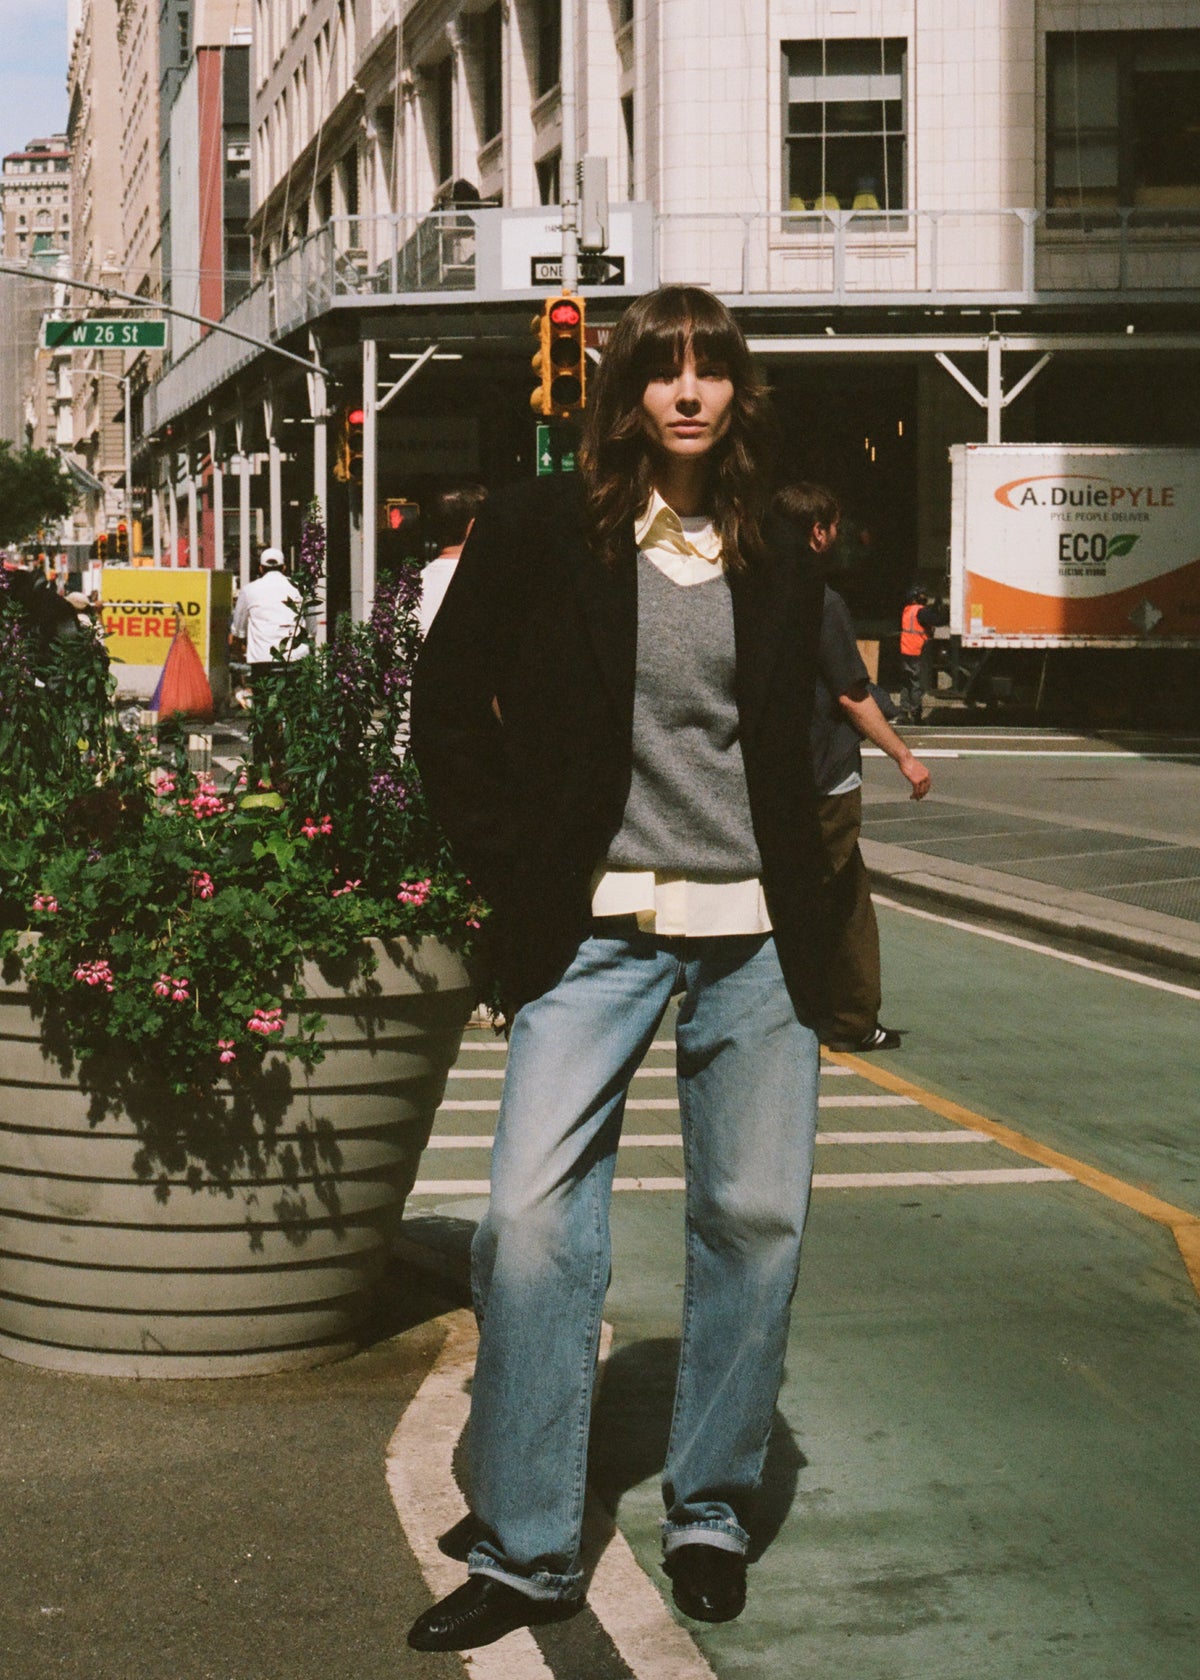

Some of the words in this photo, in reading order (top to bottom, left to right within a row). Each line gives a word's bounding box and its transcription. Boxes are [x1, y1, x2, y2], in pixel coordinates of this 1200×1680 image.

[73, 326, 87, 342] W
[94, 326, 115, 342] 26
[121, 326, 138, 342] St
[1020, 487, 1046, 506] A.
[1051, 485, 1175, 507] DuiePYLE
[1050, 512, 1072, 521] PYLE
[1075, 512, 1109, 521] PEOPLE
[1111, 512, 1150, 522] DELIVER
[1058, 533, 1107, 562] ECO
[108, 600, 164, 615] YOUR
[172, 601, 201, 616] AD
[106, 616, 177, 638] HERE
